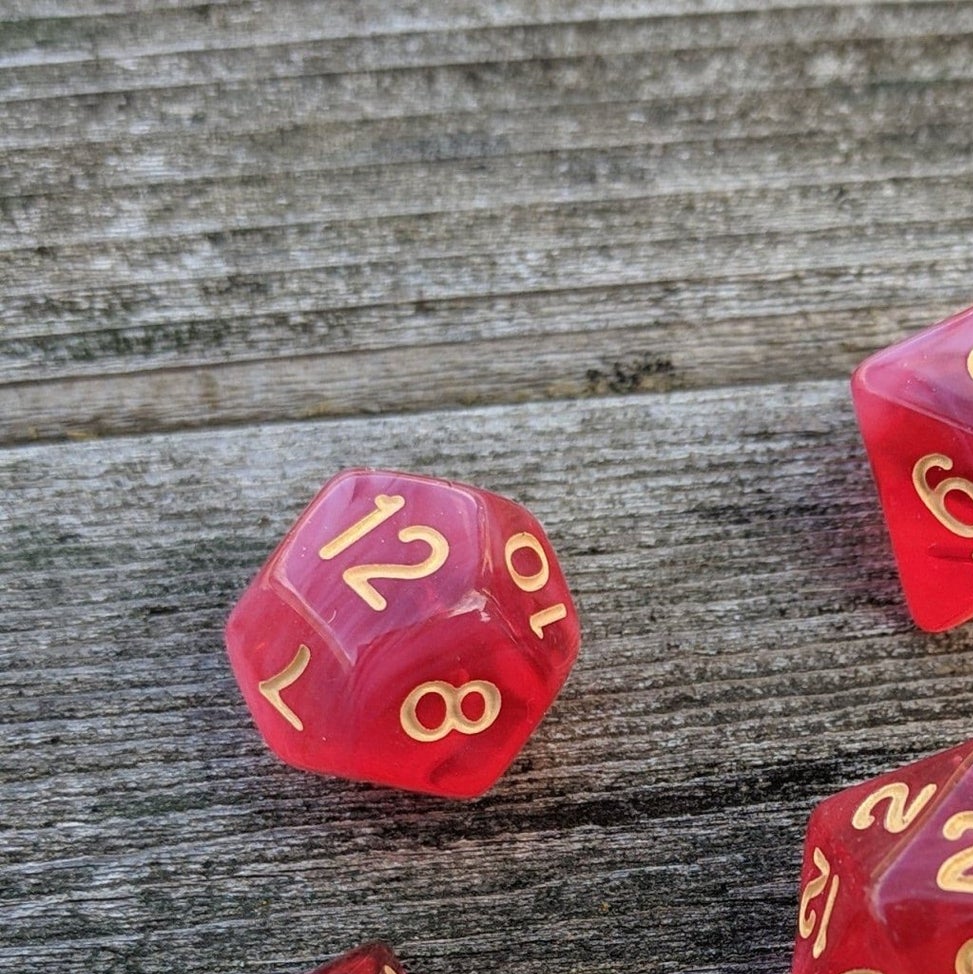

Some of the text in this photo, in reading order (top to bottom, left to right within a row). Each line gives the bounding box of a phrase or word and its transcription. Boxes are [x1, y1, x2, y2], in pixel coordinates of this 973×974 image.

[318, 494, 449, 611] 12
[505, 532, 567, 639] 10
[259, 644, 310, 731] 7
[400, 680, 501, 741] 8
[852, 782, 937, 833] 2
